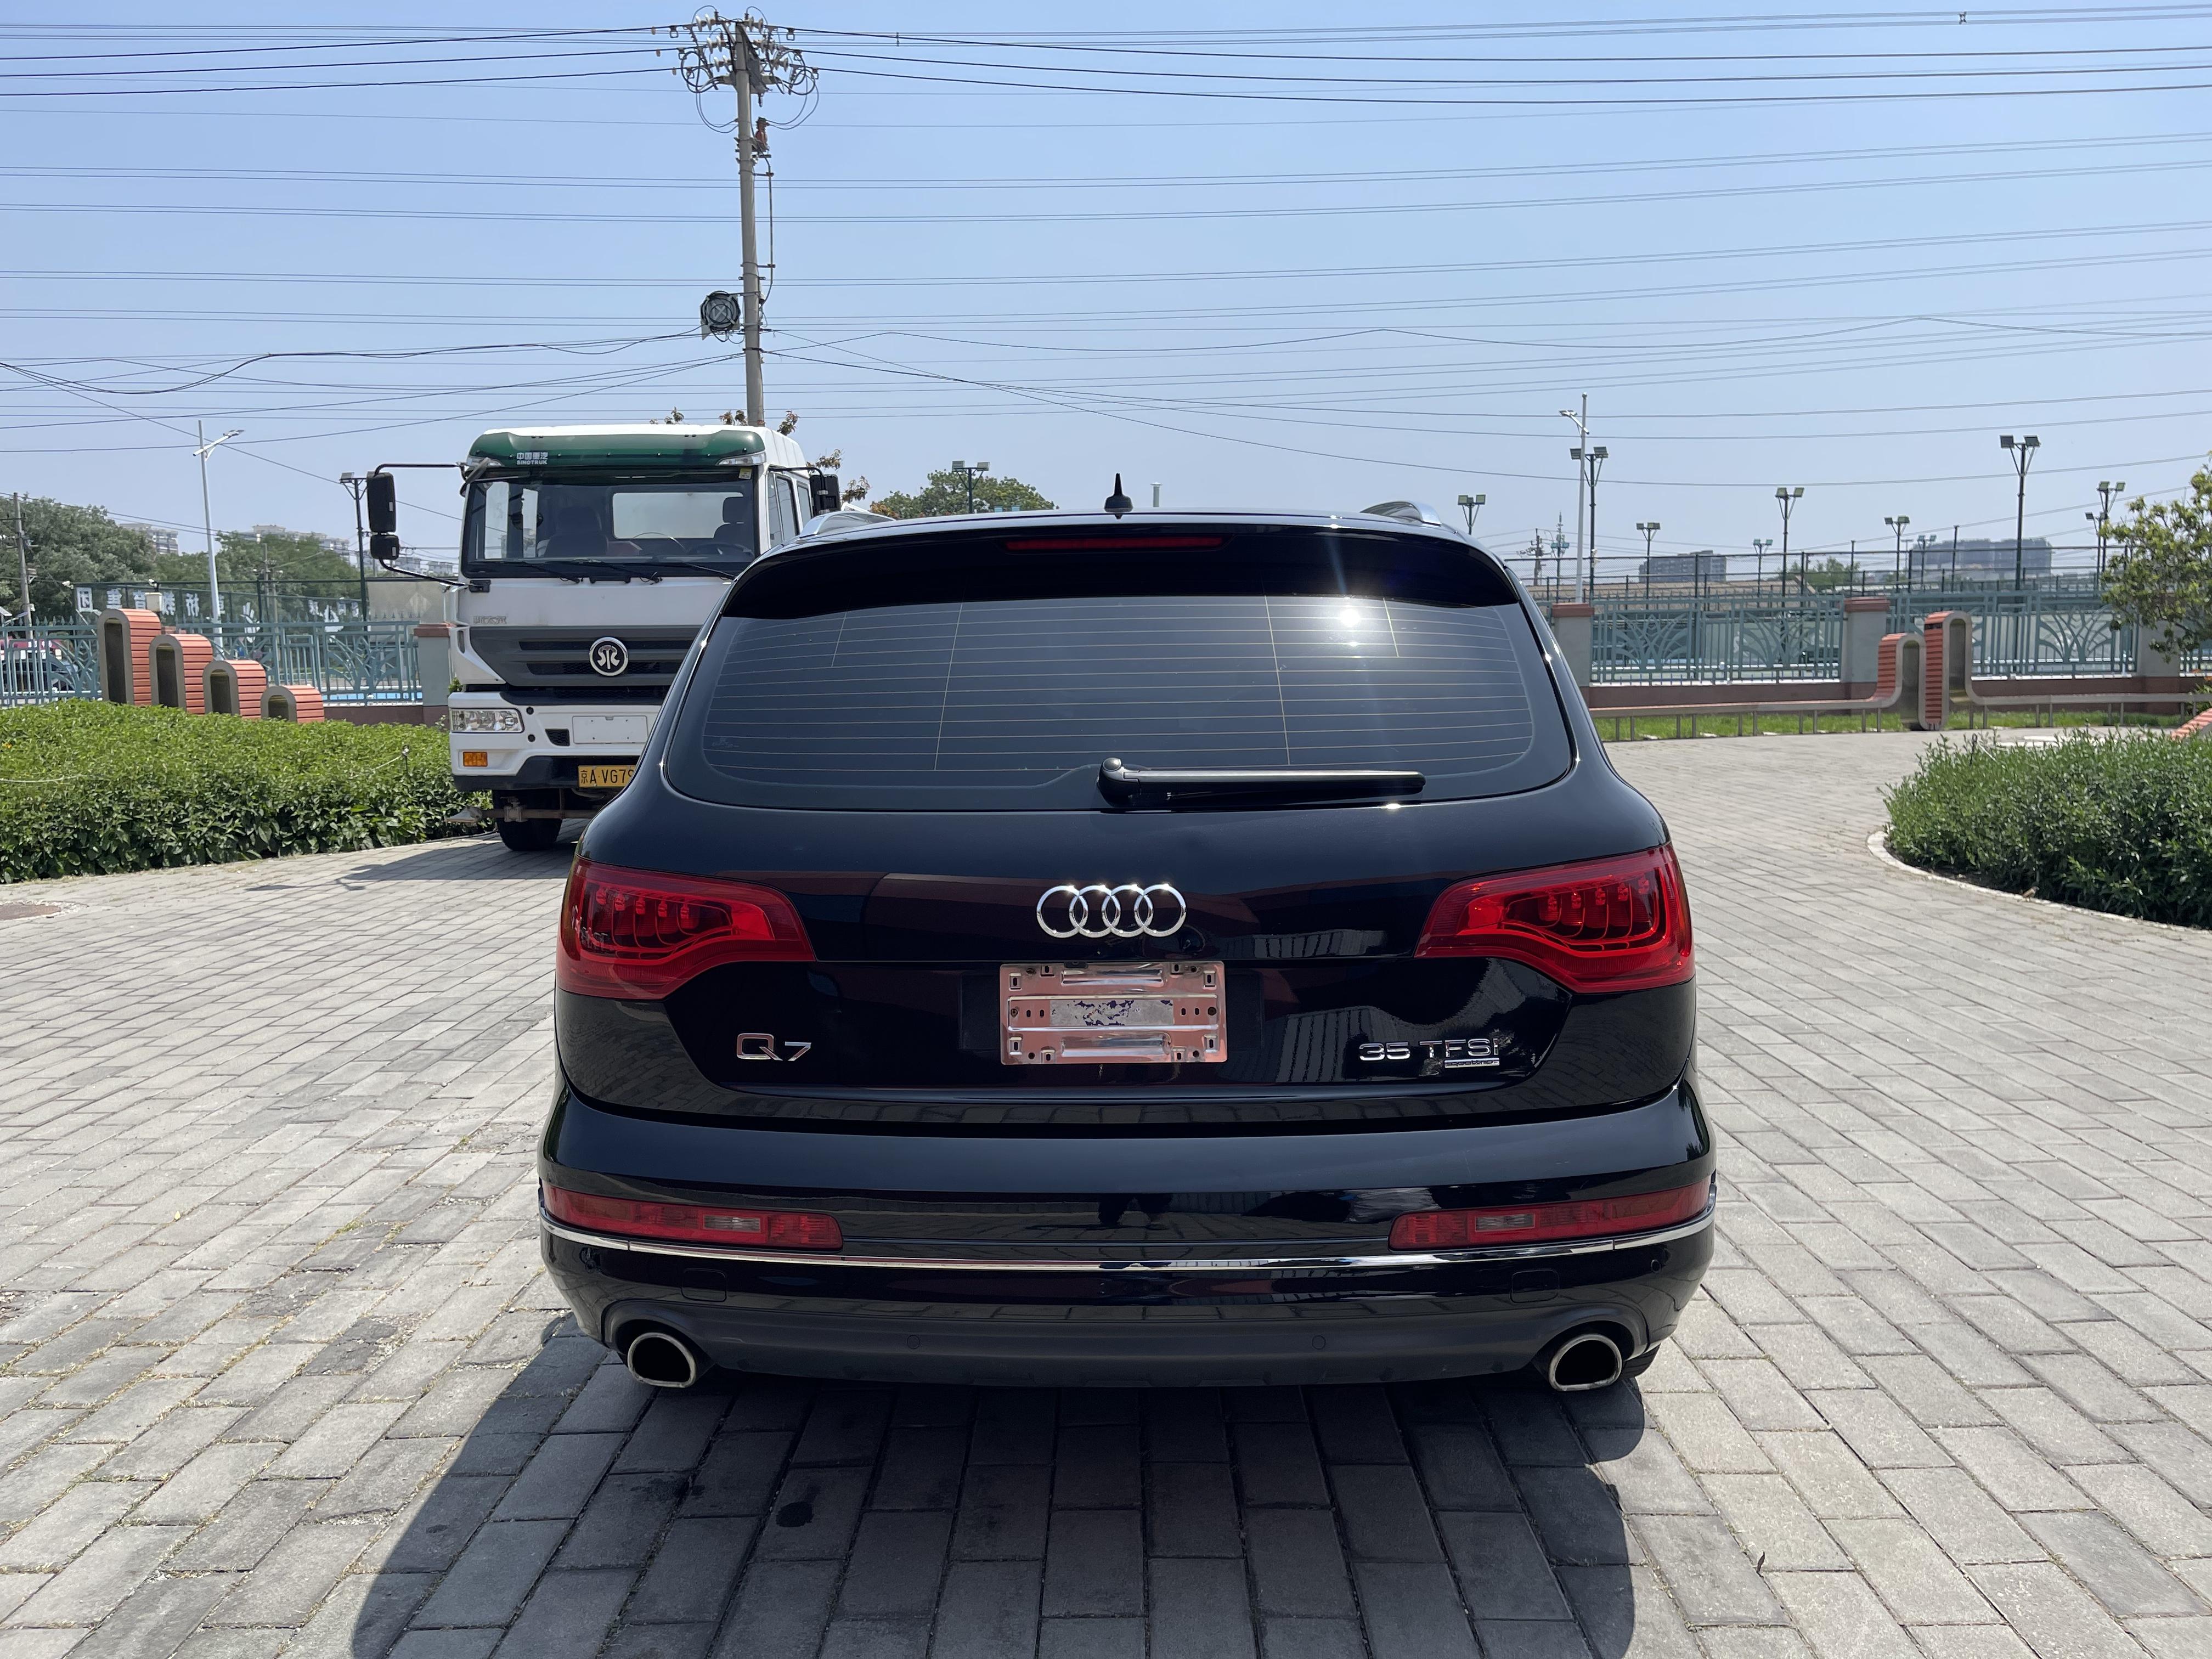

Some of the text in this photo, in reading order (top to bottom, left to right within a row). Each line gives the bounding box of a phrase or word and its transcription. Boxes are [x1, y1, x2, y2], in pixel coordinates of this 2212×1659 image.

[736, 1032, 811, 1062] Q7
[1359, 1038, 1499, 1061] 35 TFSI
